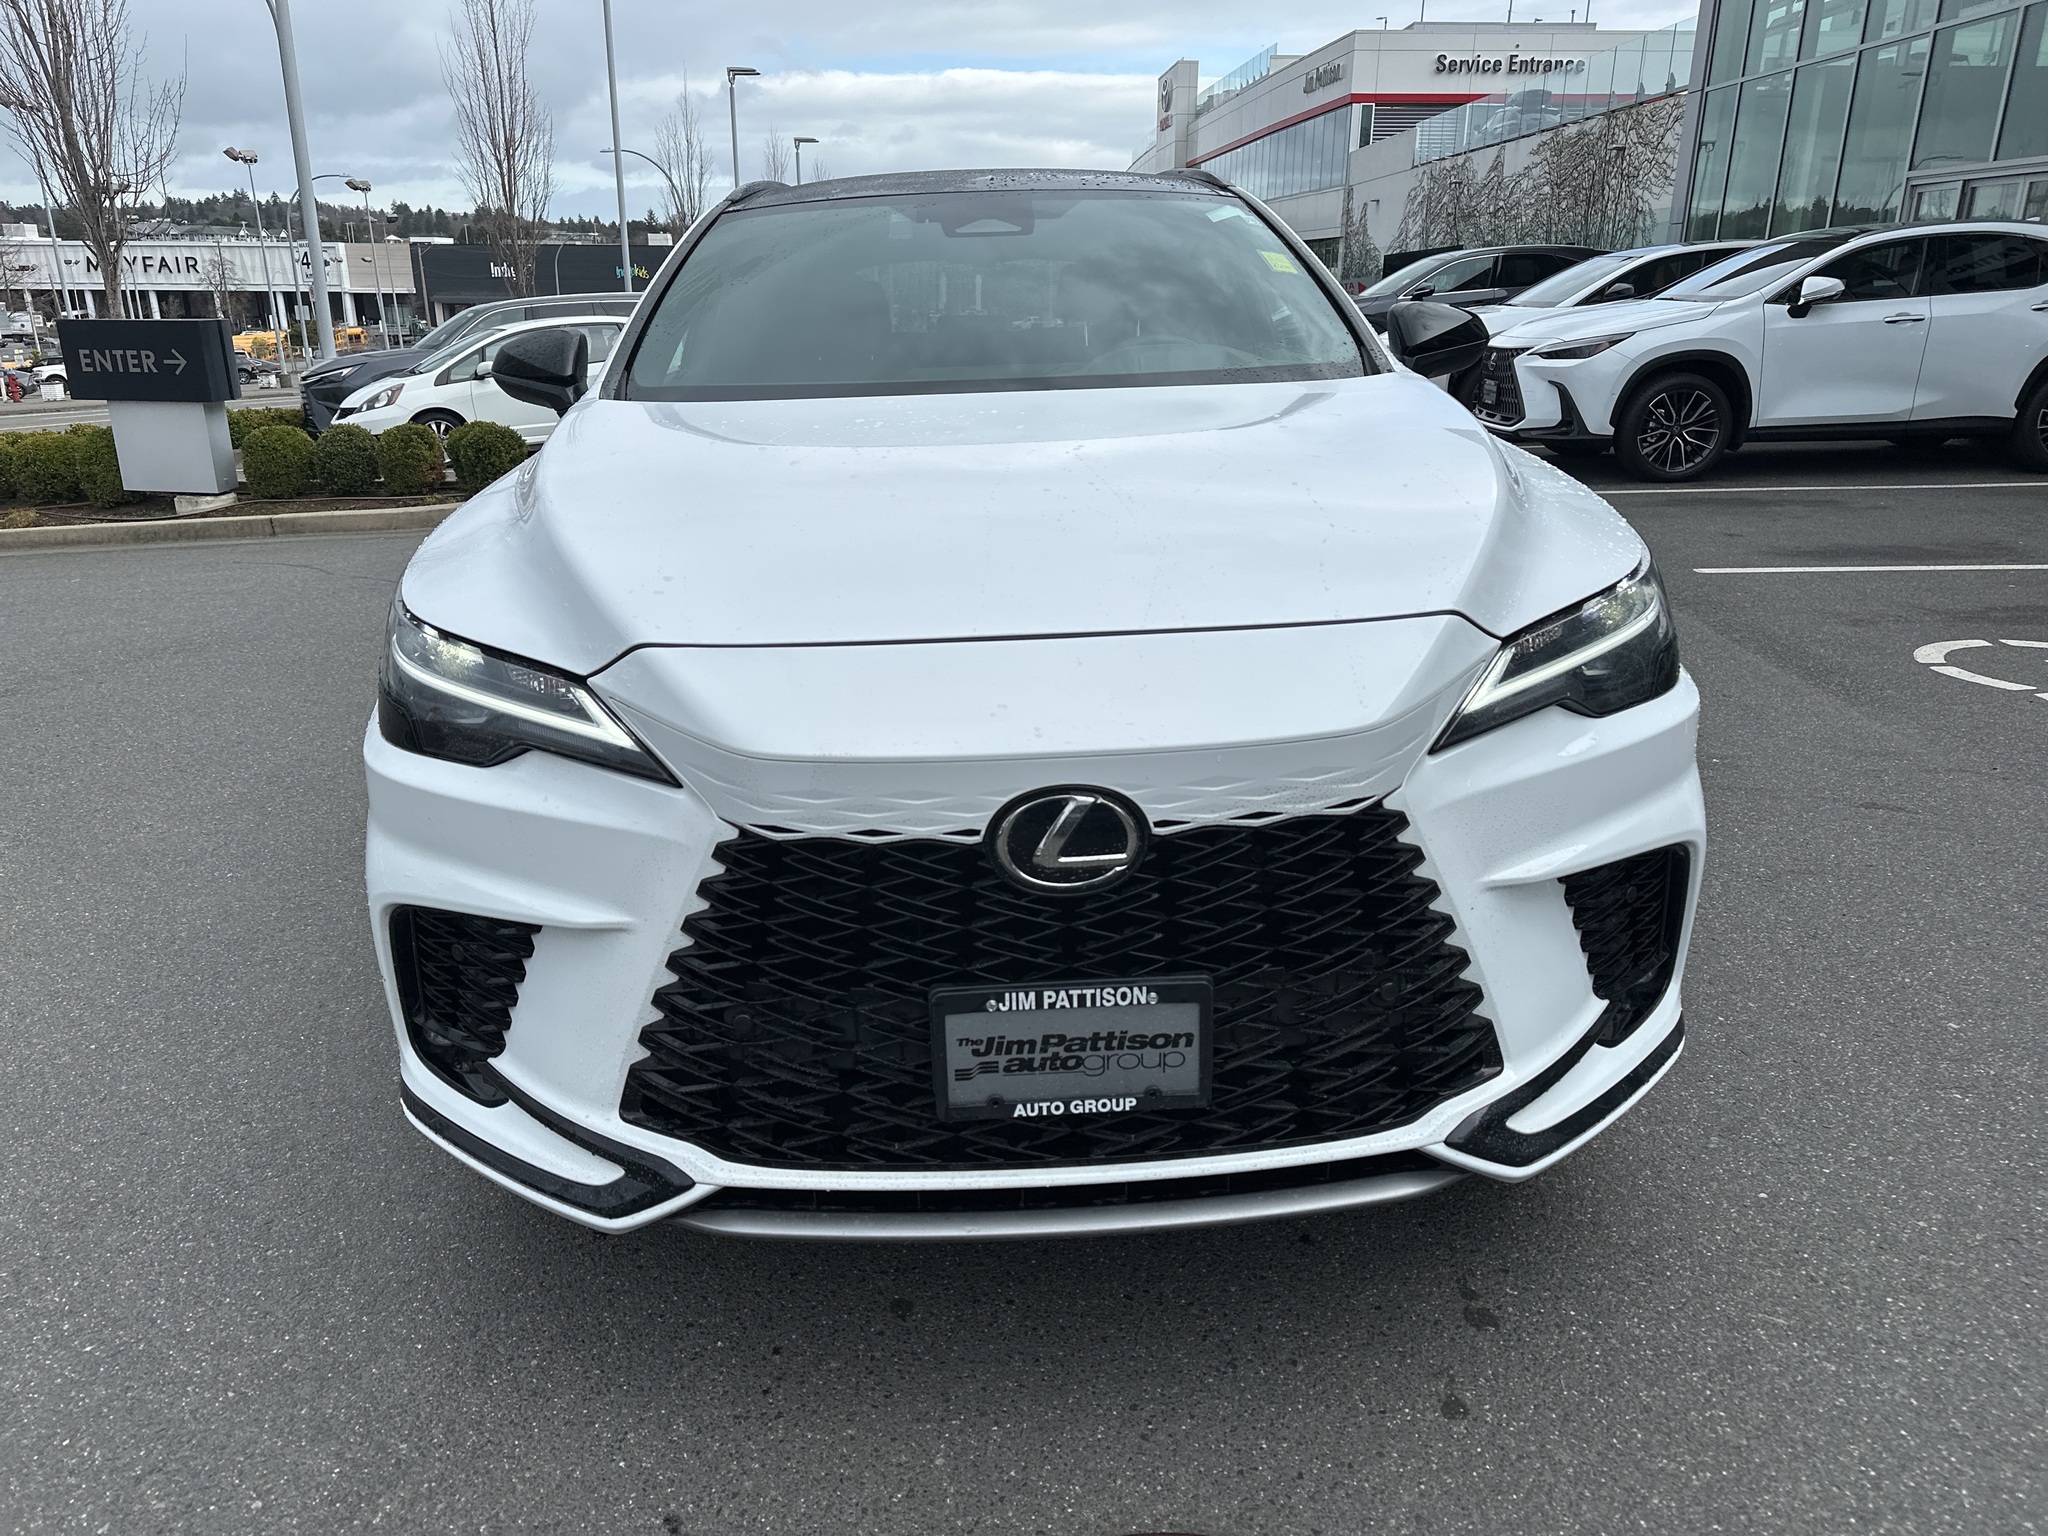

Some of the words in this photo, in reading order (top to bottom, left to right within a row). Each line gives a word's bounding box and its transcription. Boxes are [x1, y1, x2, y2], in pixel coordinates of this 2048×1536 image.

[1435, 54, 1502, 74] Service
[1507, 53, 1585, 75] Entrance
[86, 255, 199, 273] MYFAIR
[78, 349, 158, 373] ENTER
[998, 991, 1036, 1012] JIM
[1043, 986, 1148, 1010] PATTISON
[956, 1036, 984, 1047] The
[971, 1034, 1038, 1057] Jim
[1038, 1030, 1195, 1055] Pattison
[1013, 1101, 1065, 1118] AUTO
[1069, 1097, 1137, 1114] GROUP
